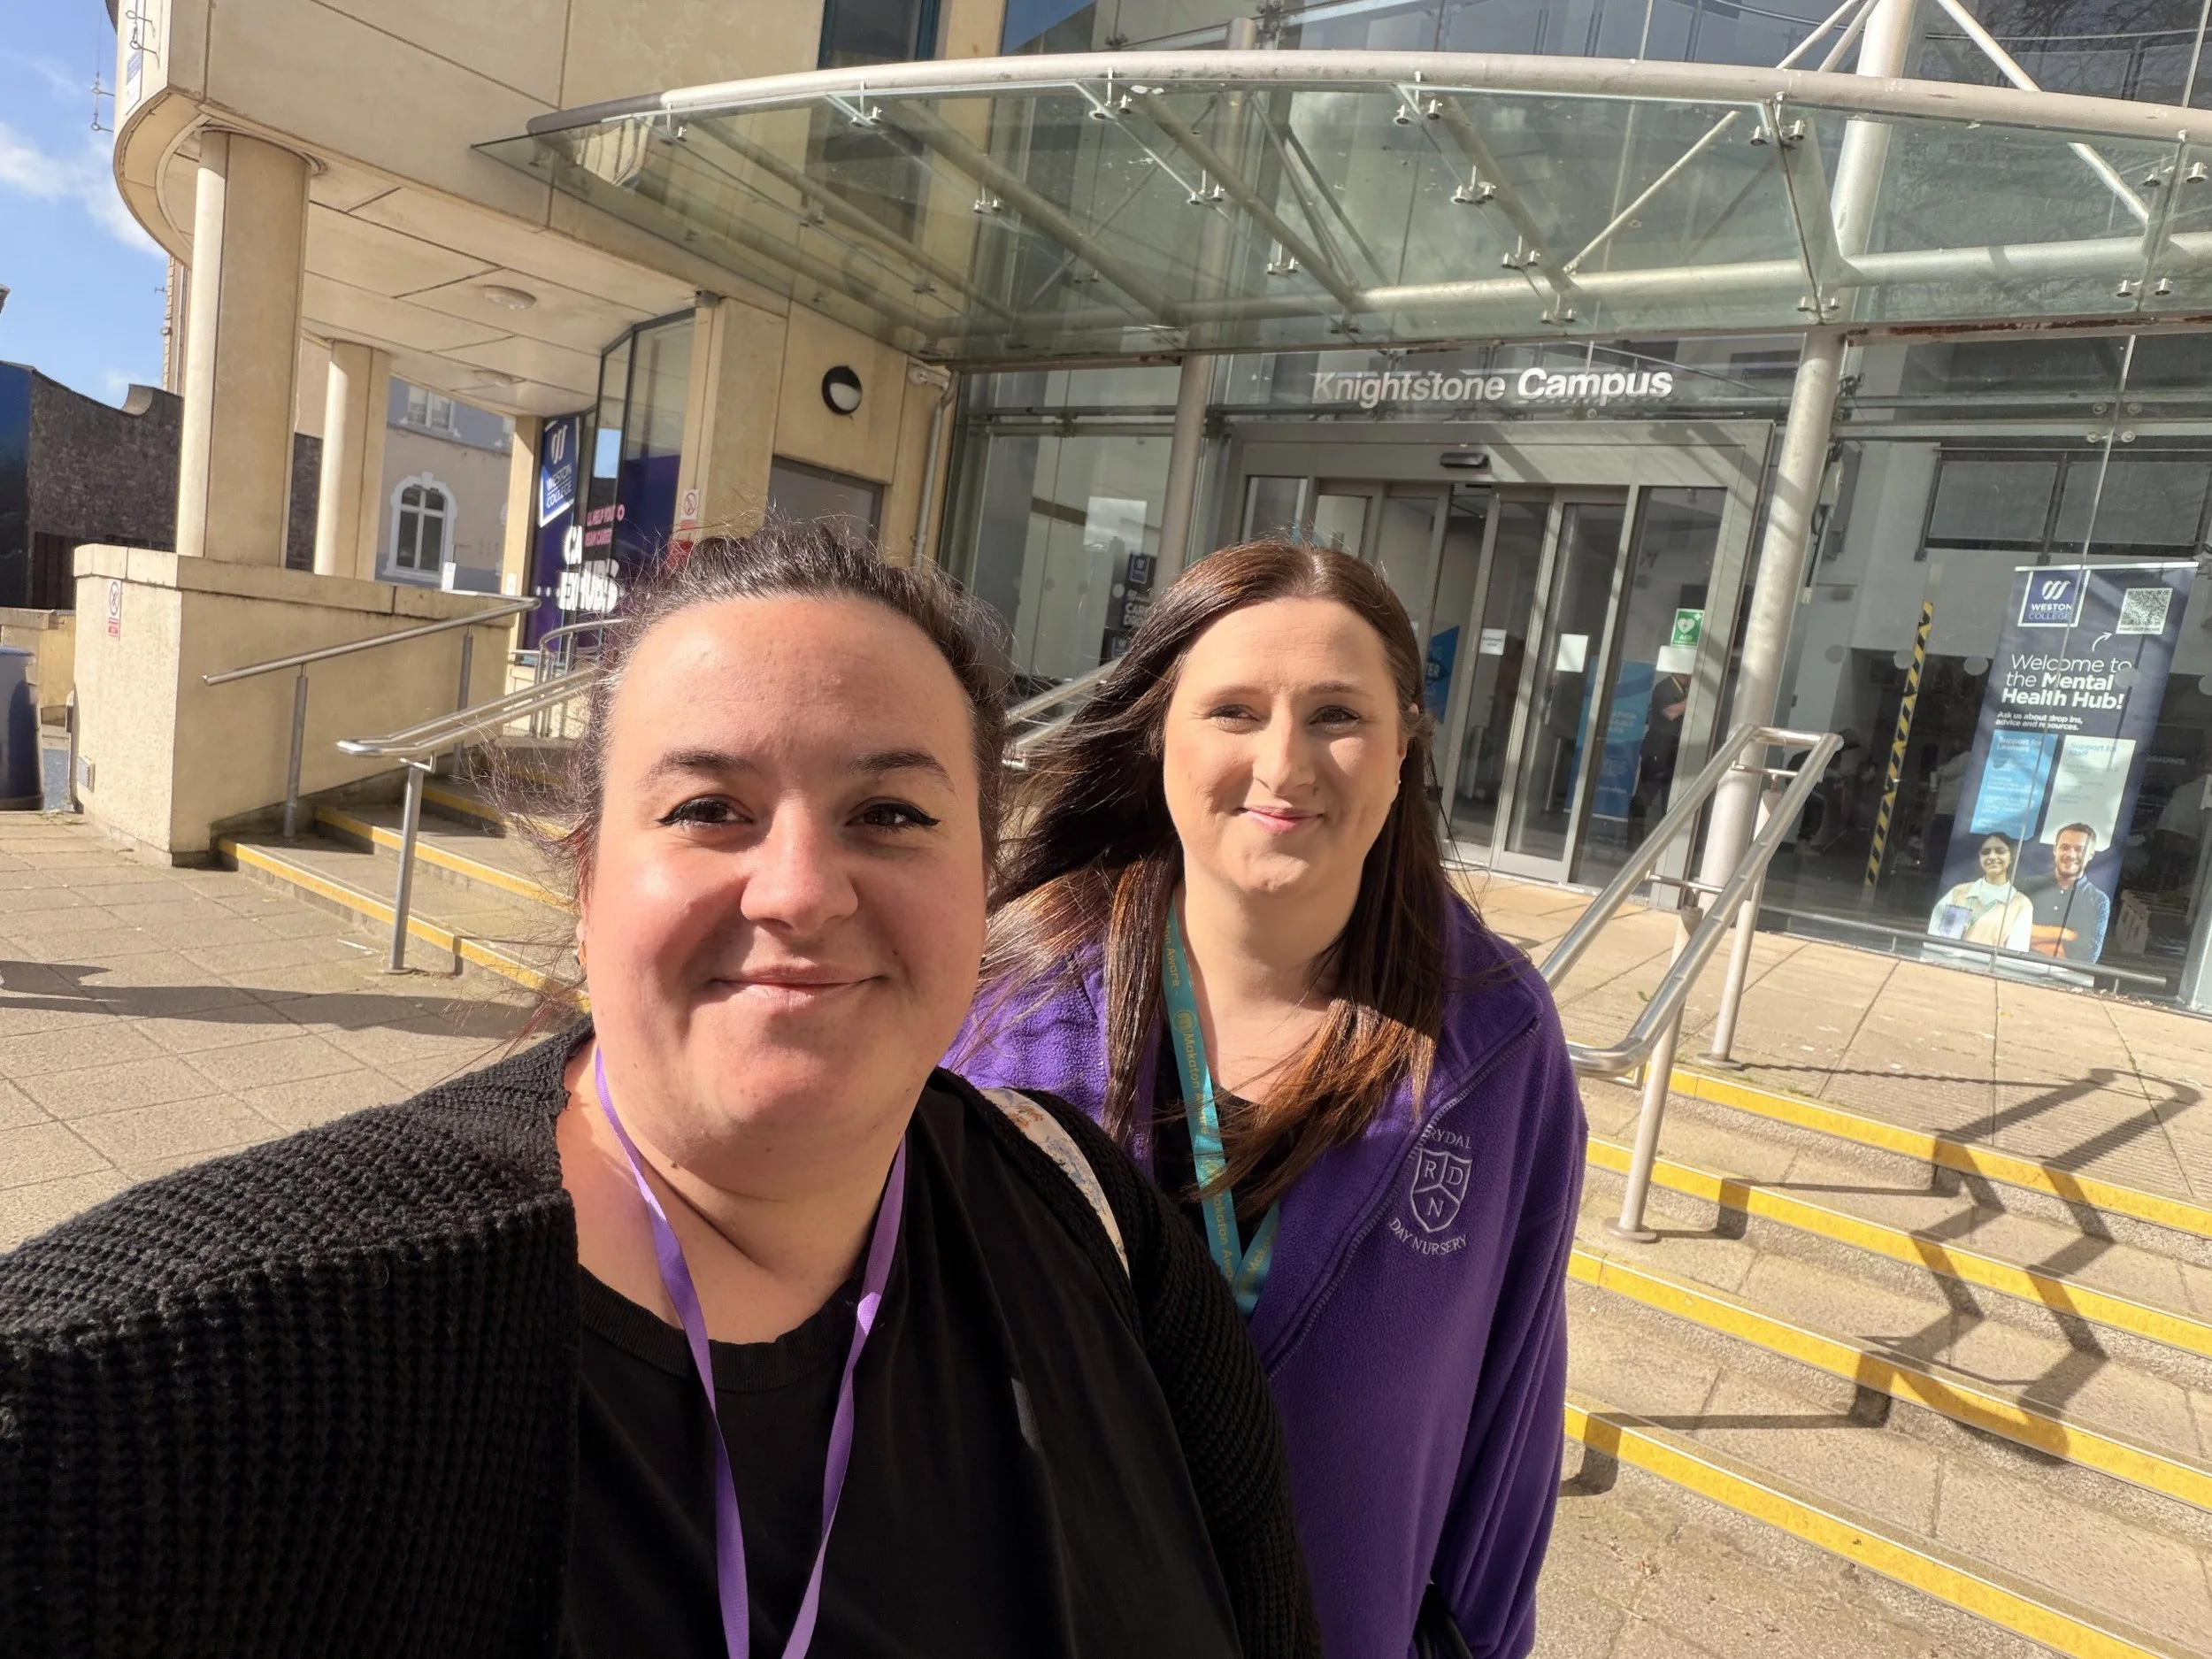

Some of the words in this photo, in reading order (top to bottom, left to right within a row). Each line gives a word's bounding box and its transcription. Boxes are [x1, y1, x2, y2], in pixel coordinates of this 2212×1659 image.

[1312, 371, 1506, 409] Knightstone
[1517, 367, 1673, 406] Campus
[546, 462, 572, 491] WESTON
[546, 480, 572, 509] COLLEGE
[2031, 603, 2072, 611] WESTON
[2010, 653, 2105, 673] Welcome
[2109, 657, 2133, 673] to
[2006, 671, 2037, 687] the
[2041, 672, 2115, 691] Mental
[2001, 687, 2068, 707] Health
[2071, 691, 2125, 710] Hub!
[1997, 710, 2012, 719] Ask
[2024, 711, 2047, 721] about
[2048, 714, 2069, 724] drop
[2070, 715, 2084, 725] ins,
[2070, 742, 2104, 752] Support
[1167, 948, 1180, 987] Aware
[1182, 1033, 1201, 1089] Makaton
[1427, 1127, 1473, 1149] RYDAL
[1424, 1160, 1437, 1180] R
[1447, 1166, 1463, 1186] D
[1426, 1196, 1444, 1218] N
[1388, 1217, 1414, 1243] DAY
[1411, 1233, 1468, 1256] NURSERY
